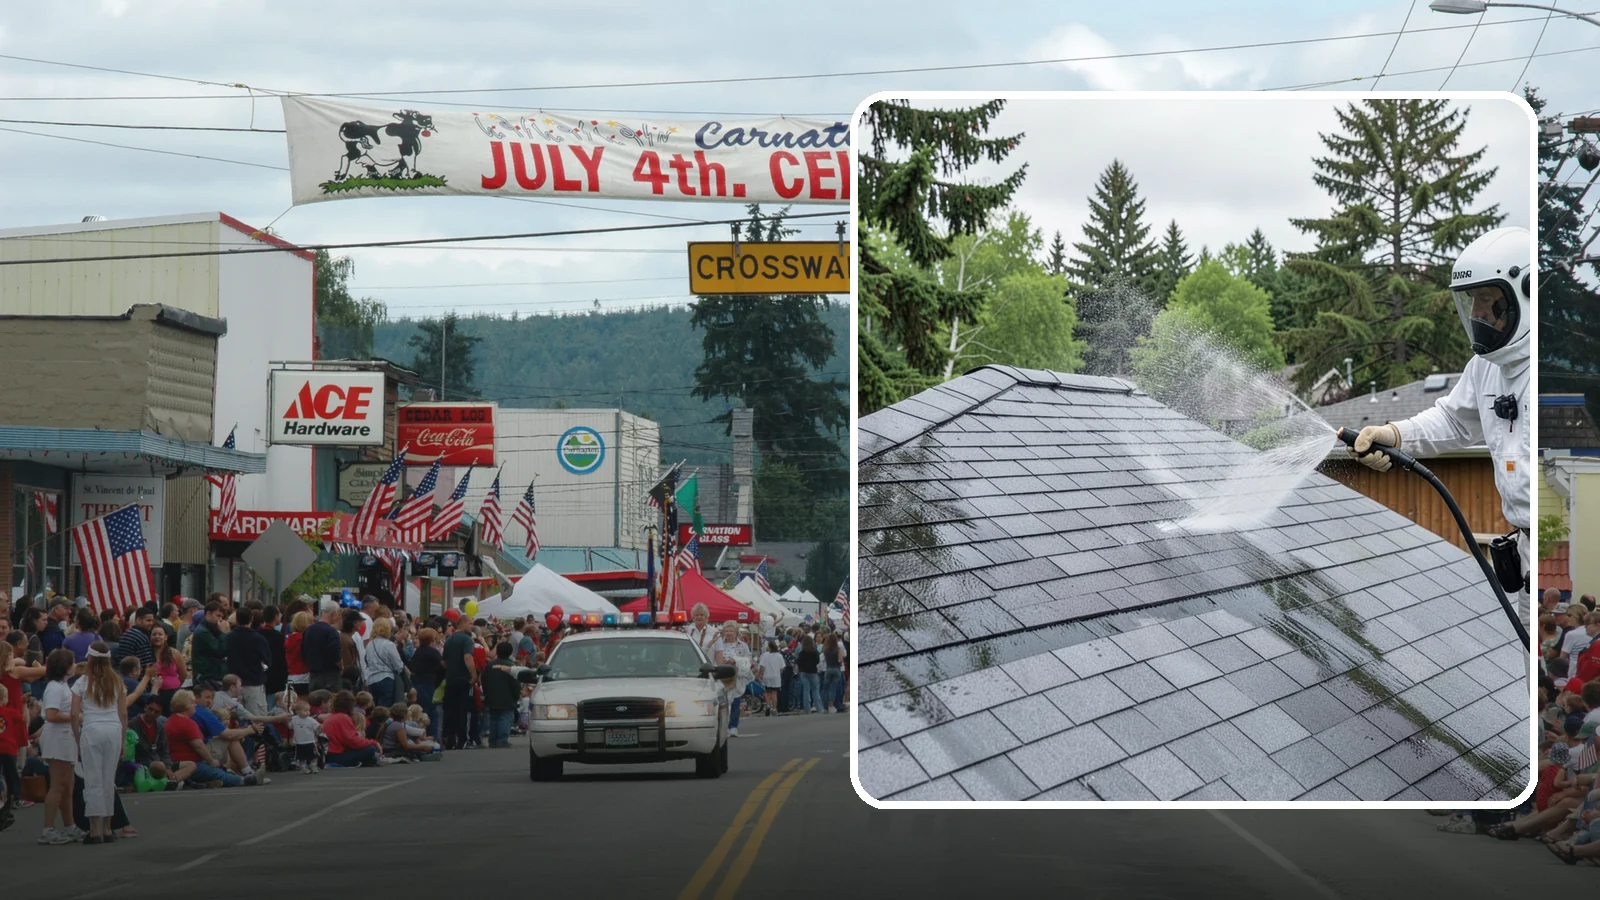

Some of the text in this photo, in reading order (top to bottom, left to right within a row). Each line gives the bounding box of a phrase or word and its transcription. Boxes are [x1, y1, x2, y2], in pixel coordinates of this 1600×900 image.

[481, 141, 605, 192] JULY
[632, 150, 746, 198] 4th.
[697, 254, 850, 280] CROSSWA
[282, 379, 374, 420] ACE
[406, 409, 485, 422] CEDAR LOG
[283, 421, 371, 436] Hardware
[416, 428, 477, 447] Coca-Cola
[353, 467, 385, 478] Simpl
[83, 485, 155, 495] St. Vincent de Paul
[688, 526, 741, 535] CRNATION
[699, 535, 730, 543] GLASS
